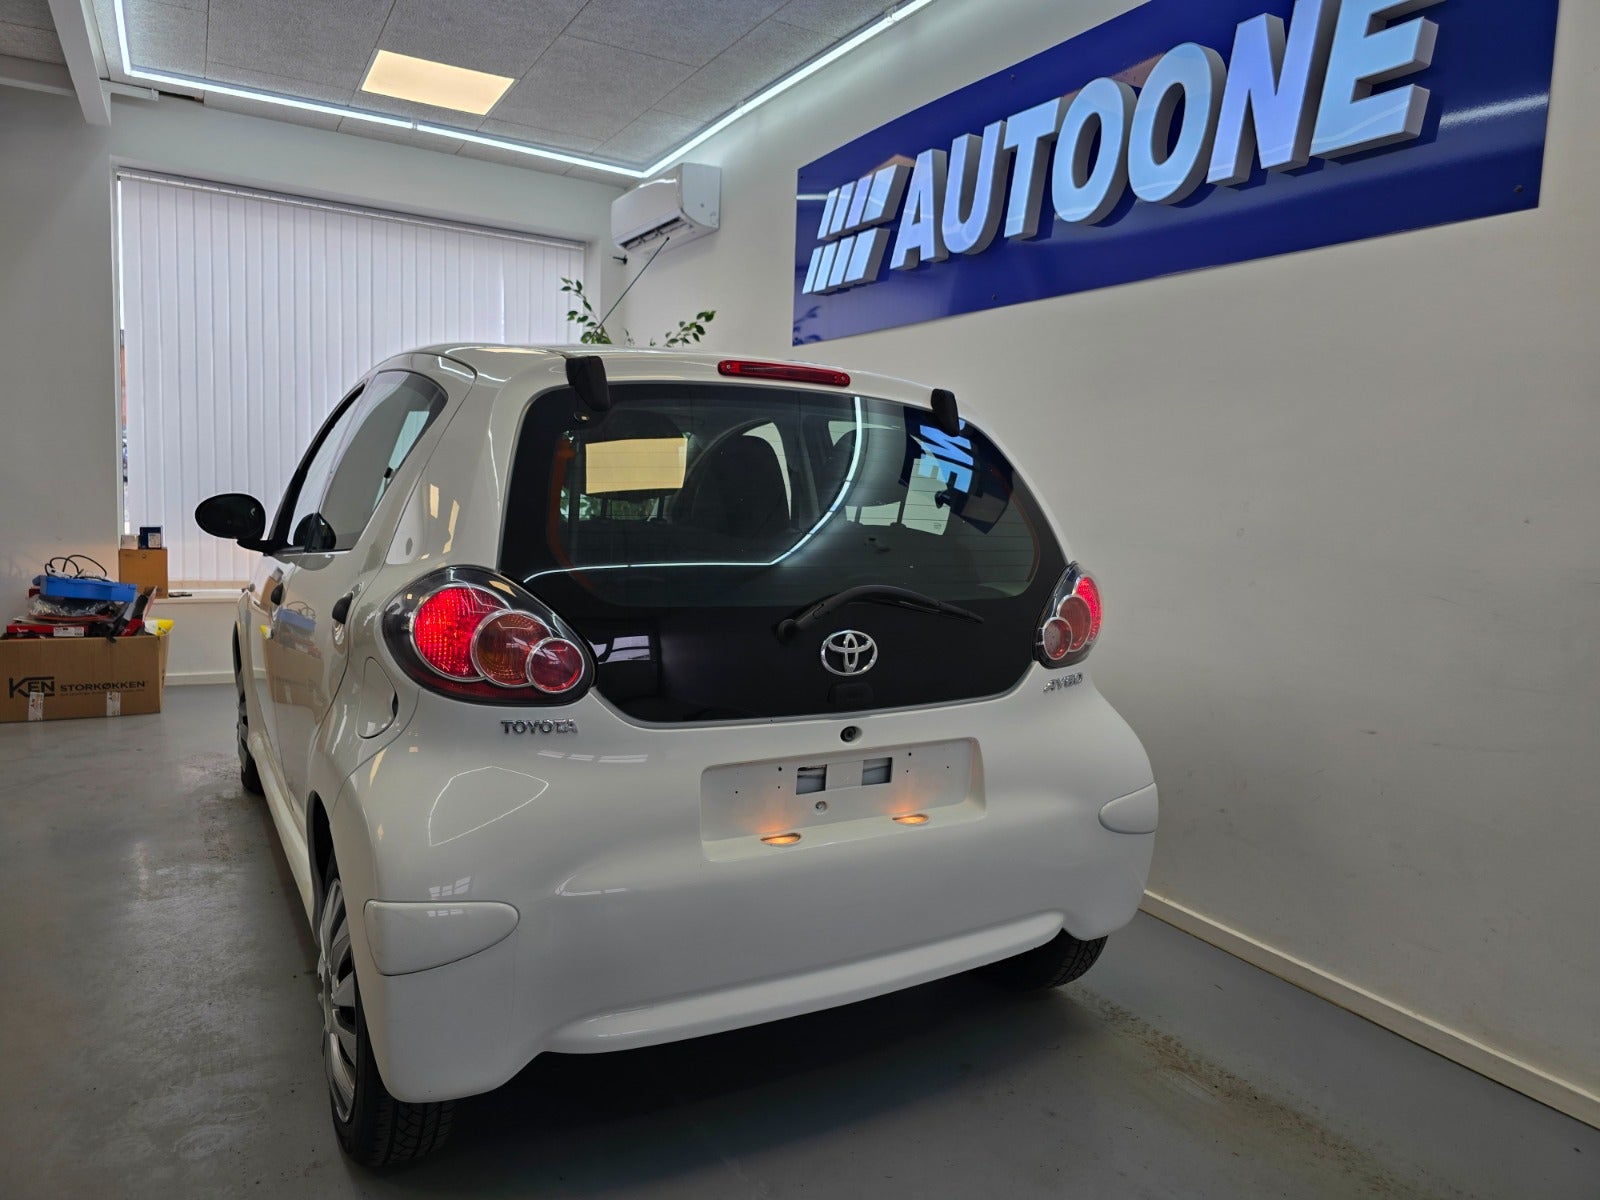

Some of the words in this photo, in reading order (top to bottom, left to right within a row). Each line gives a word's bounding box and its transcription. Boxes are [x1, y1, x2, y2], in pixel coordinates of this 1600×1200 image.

[889, 0, 1440, 270] AUTOONE
[9, 676, 55, 699] KEN
[60, 680, 146, 692] STORKØKKEN
[500, 719, 578, 734] TOYOTA
